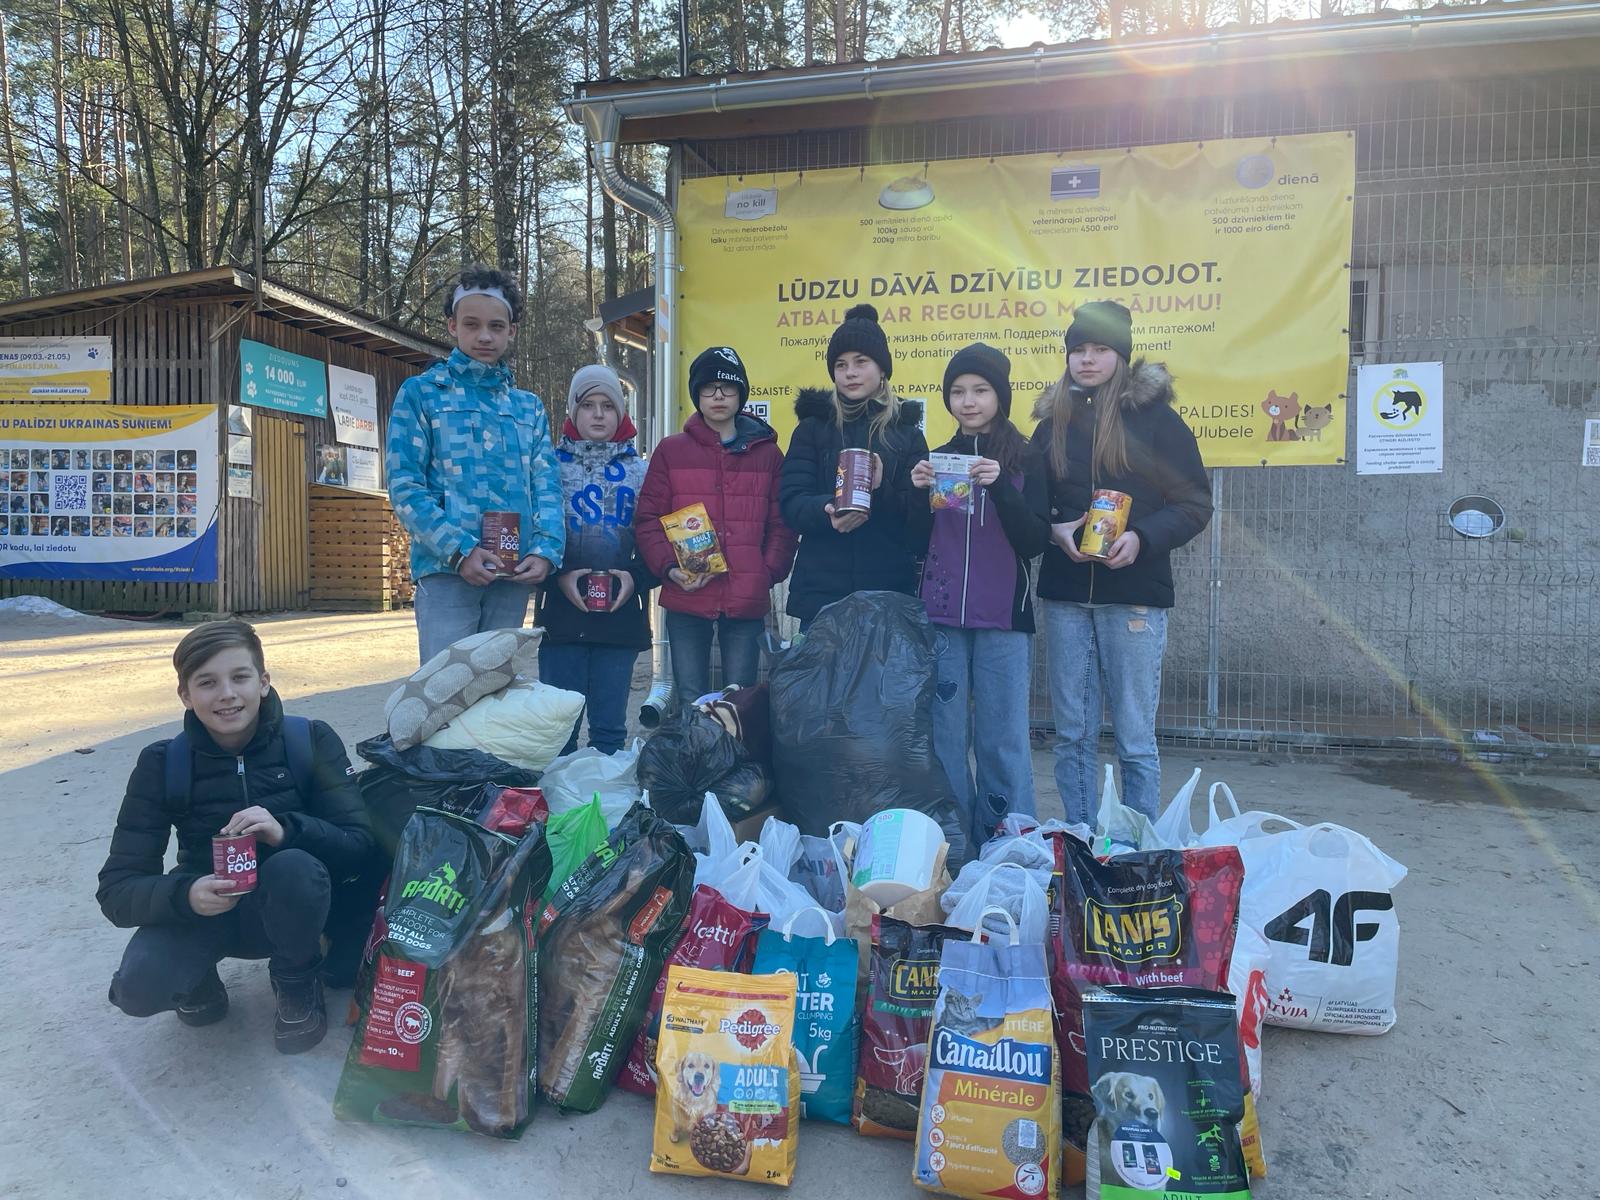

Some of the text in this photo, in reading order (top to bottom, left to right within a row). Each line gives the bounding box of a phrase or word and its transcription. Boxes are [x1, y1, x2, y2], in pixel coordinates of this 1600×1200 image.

[1278, 172, 1319, 186] dienā
[737, 198, 767, 209] no kill
[859, 218, 873, 226] 500
[1212, 216, 1229, 225] 500
[877, 227, 898, 235] 100kg
[1081, 224, 1101, 233] 4500
[1103, 224, 1119, 232] eiro
[1215, 225, 1222, 234] ir
[1223, 226, 1243, 234] 1000
[1245, 225, 1263, 233] eiro
[872, 236, 895, 245] 200kg
[778, 261, 1222, 303] LŪDZU DĀVĀ DZĪVĪBU ZIEDOJOT.
[777, 293, 1222, 328] ATBAL AR REGULĀRO MĀJUMU!
[893, 332, 928, 344] жизнь
[931, 330, 1001, 342] обитателям.
[1004, 327, 1066, 341] Поддержи
[1149, 321, 1216, 336] платежом!
[894, 350, 908, 361] by
[1015, 346, 1028, 355] us
[1030, 344, 1057, 355] with
[264, 364, 276, 382] 14
[277, 368, 295, 386] 000
[908, 383, 943, 393] PAYPA
[1179, 404, 1254, 419] PALDIES!
[13, 416, 172, 431] PALĪDZI UKRAINAS SUŅIEM!
[355, 418, 375, 433] DARBI
[1192, 425, 1254, 439] Ulubele
[500, 534, 518, 543] DOG
[692, 531, 711, 545] ADULT
[10, 543, 32, 552] kodu,
[46, 544, 77, 552] ziedotu
[587, 584, 600, 592] CAT
[587, 591, 607, 599] FOOD
[227, 851, 249, 864] CAT
[227, 859, 257, 874] FOOD
[1135, 883, 1146, 892] dry
[1146, 881, 1158, 891] dog
[1158, 879, 1173, 889] food
[401, 876, 466, 914] APORT!
[401, 916, 446, 939] FOOD FOR
[1093, 905, 1172, 947] CANIS
[1264, 888, 1394, 967] 4F
[409, 930, 425, 941] ALL
[405, 938, 432, 950] DOGS
[1113, 941, 1167, 955] MAJOR
[397, 968, 416, 977] BEEF
[896, 964, 941, 995] CANI
[1135, 971, 1160, 986] With
[1160, 971, 1184, 983] beef
[609, 946, 645, 1038] ADULT ALL BREED DOGS
[675, 1016, 704, 1027] WALTHAM
[797, 1011, 833, 1021] CLUMPING
[720, 1018, 780, 1037] Pedigree
[809, 1022, 832, 1041] 5kg
[387, 1047, 398, 1056] 10
[935, 1030, 1044, 1078] Canaillou
[1100, 1036, 1223, 1066] PRESTIGE
[592, 1043, 615, 1080] APORT!
[734, 1067, 780, 1088] ADULT
[954, 1078, 1035, 1107] Minérale
